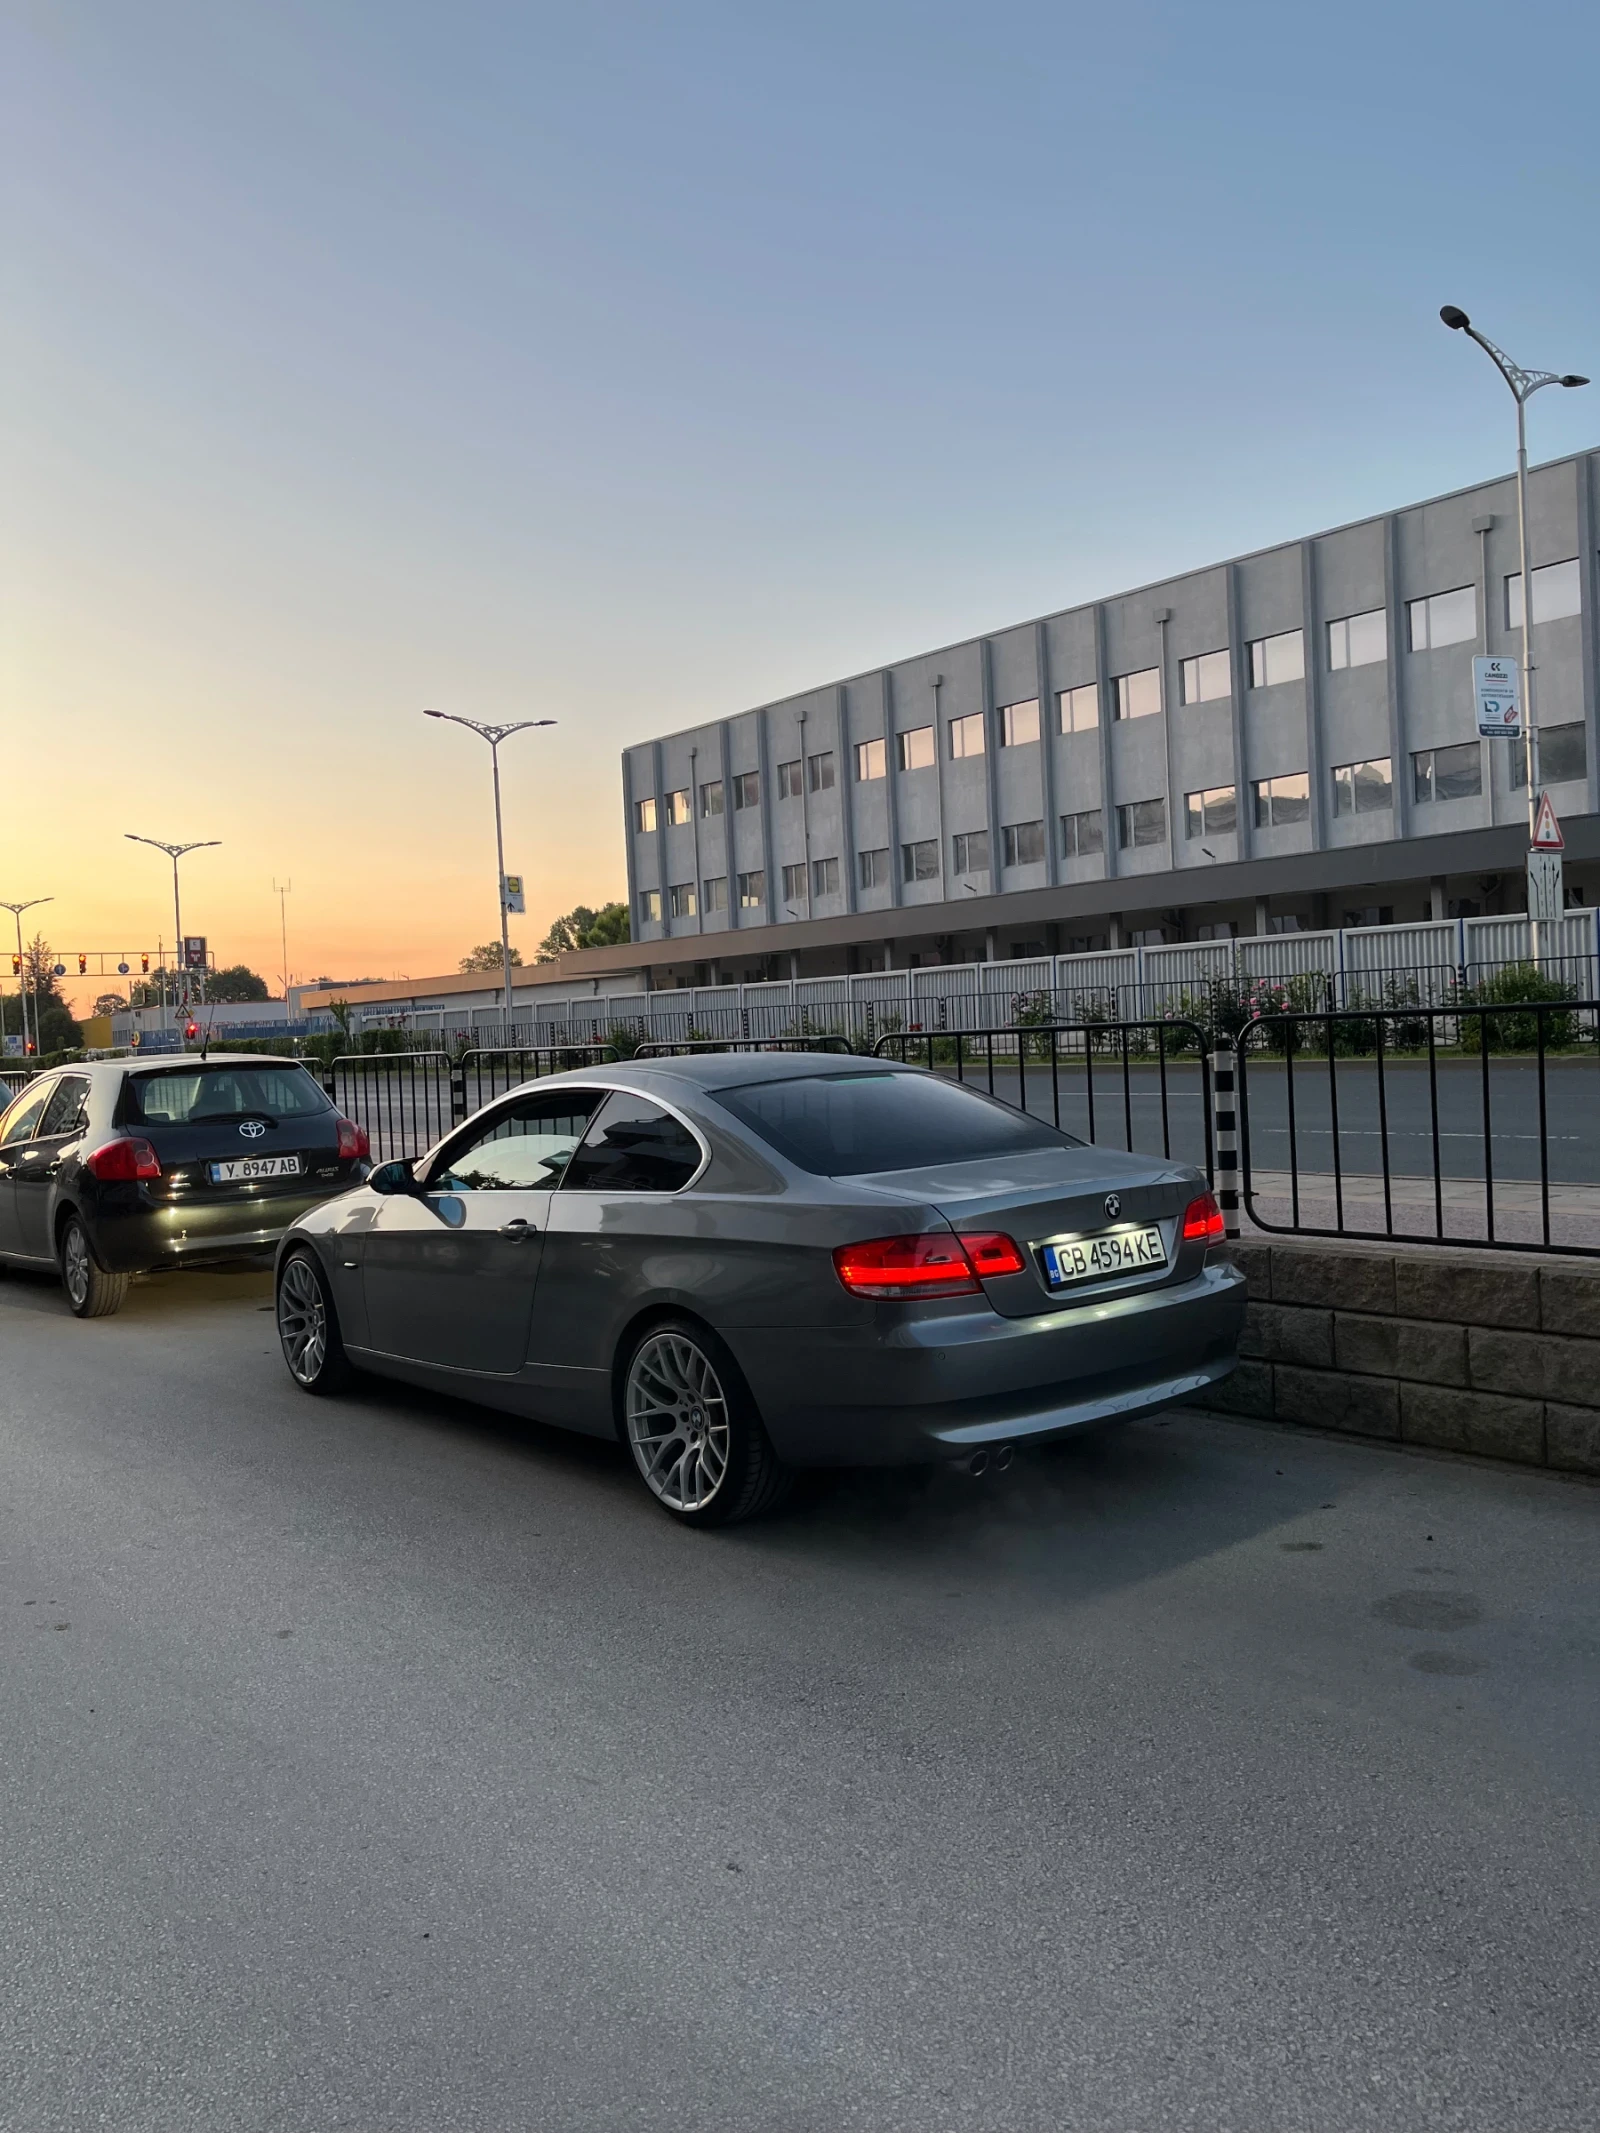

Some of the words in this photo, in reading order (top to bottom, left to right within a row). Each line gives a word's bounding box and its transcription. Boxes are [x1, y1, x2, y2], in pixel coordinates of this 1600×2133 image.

[243, 1160, 276, 1177] 8947
[279, 1158, 297, 1174] AB
[1059, 1247, 1087, 1276] CB
[1090, 1237, 1134, 1270] 4594
[1135, 1232, 1161, 1261] KE
